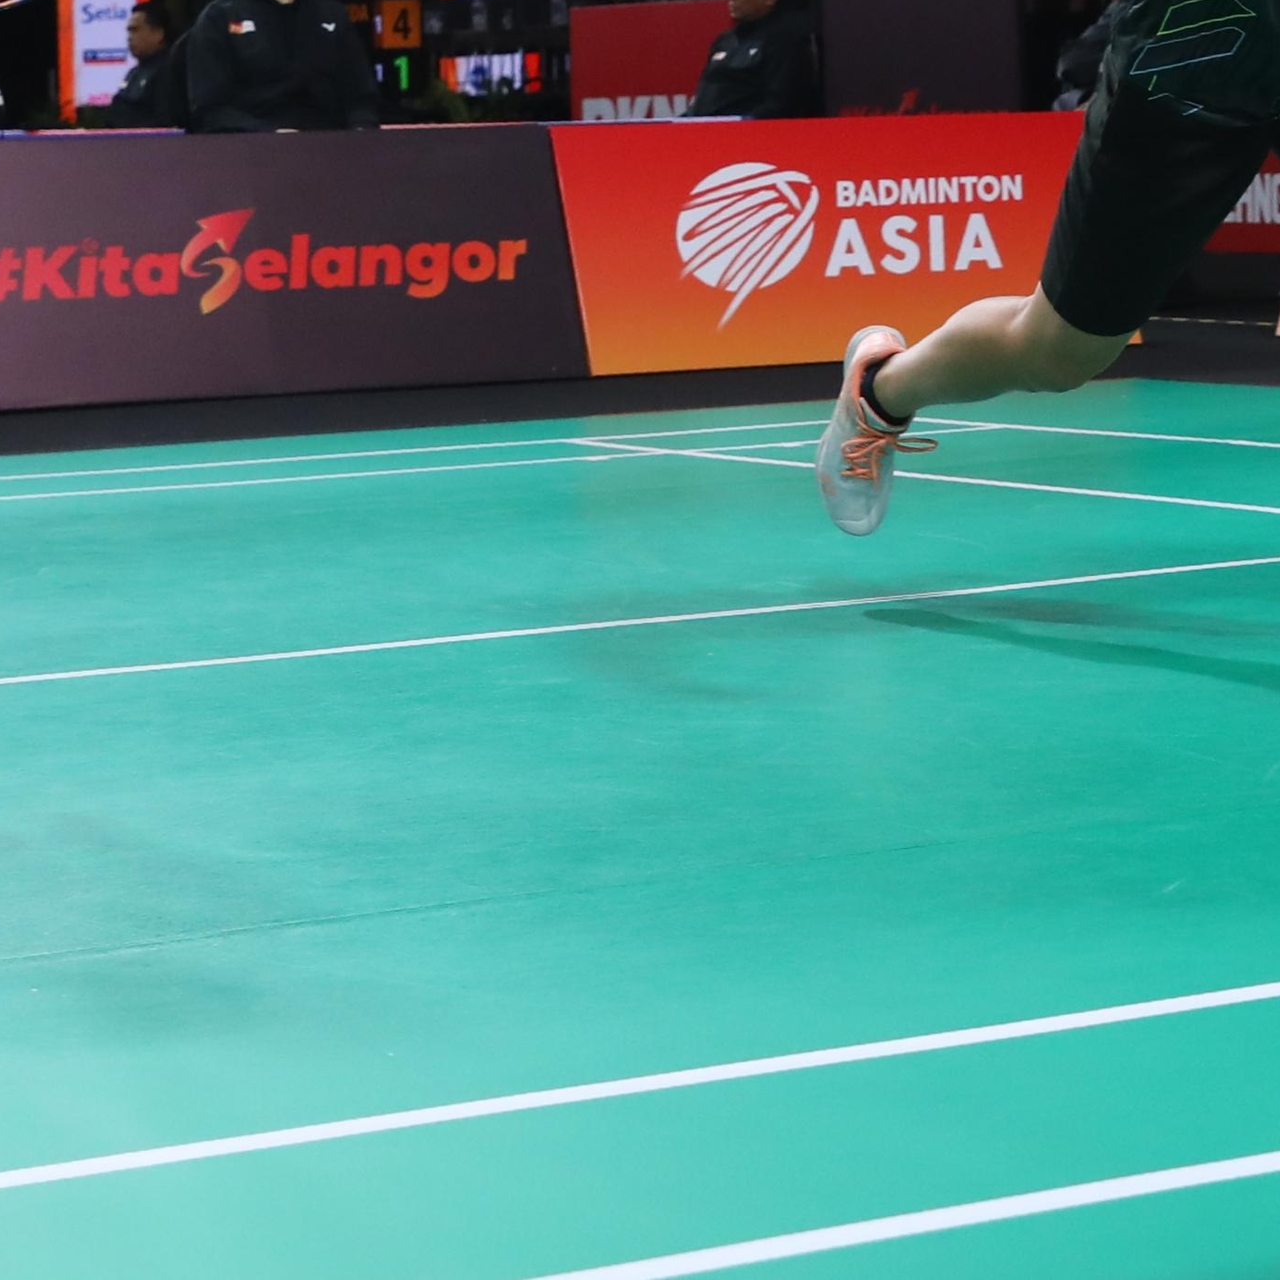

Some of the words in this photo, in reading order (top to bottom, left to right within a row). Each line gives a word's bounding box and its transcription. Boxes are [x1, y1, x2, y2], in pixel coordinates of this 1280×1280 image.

[393, 8, 412, 40] 4
[394, 55, 410, 89] 1
[836, 174, 1024, 209] BADMINTON
[825, 213, 1004, 278] ASIA
